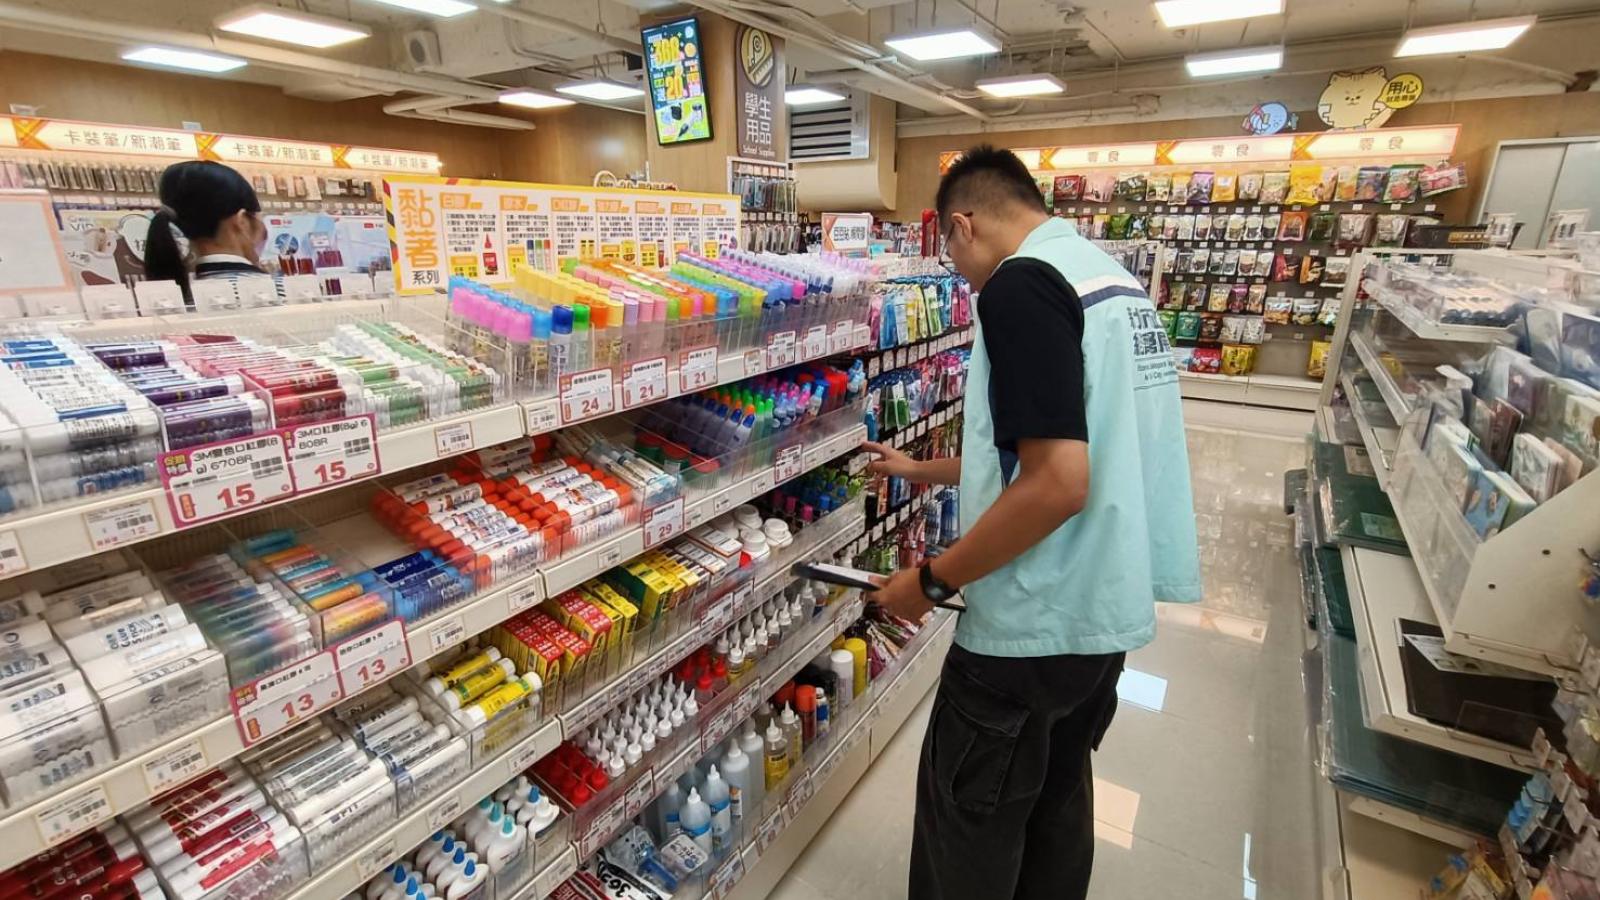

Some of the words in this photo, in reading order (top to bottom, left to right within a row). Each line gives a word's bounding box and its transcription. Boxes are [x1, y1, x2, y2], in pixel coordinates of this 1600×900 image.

[1387, 80, 1418, 95] 用心
[1211, 143, 1250, 158] 零食
[1359, 136, 1404, 152] 零食
[412, 269, 440, 285] 系列
[694, 371, 706, 384] 21
[639, 384, 654, 399] 21
[581, 397, 599, 413] 24
[360, 419, 367, 427] 6
[210, 454, 253, 471] 6708R
[314, 460, 346, 484] 15
[217, 483, 255, 510] 15
[659, 523, 673, 537] 29
[357, 659, 386, 681] 13
[281, 693, 314, 718] 13
